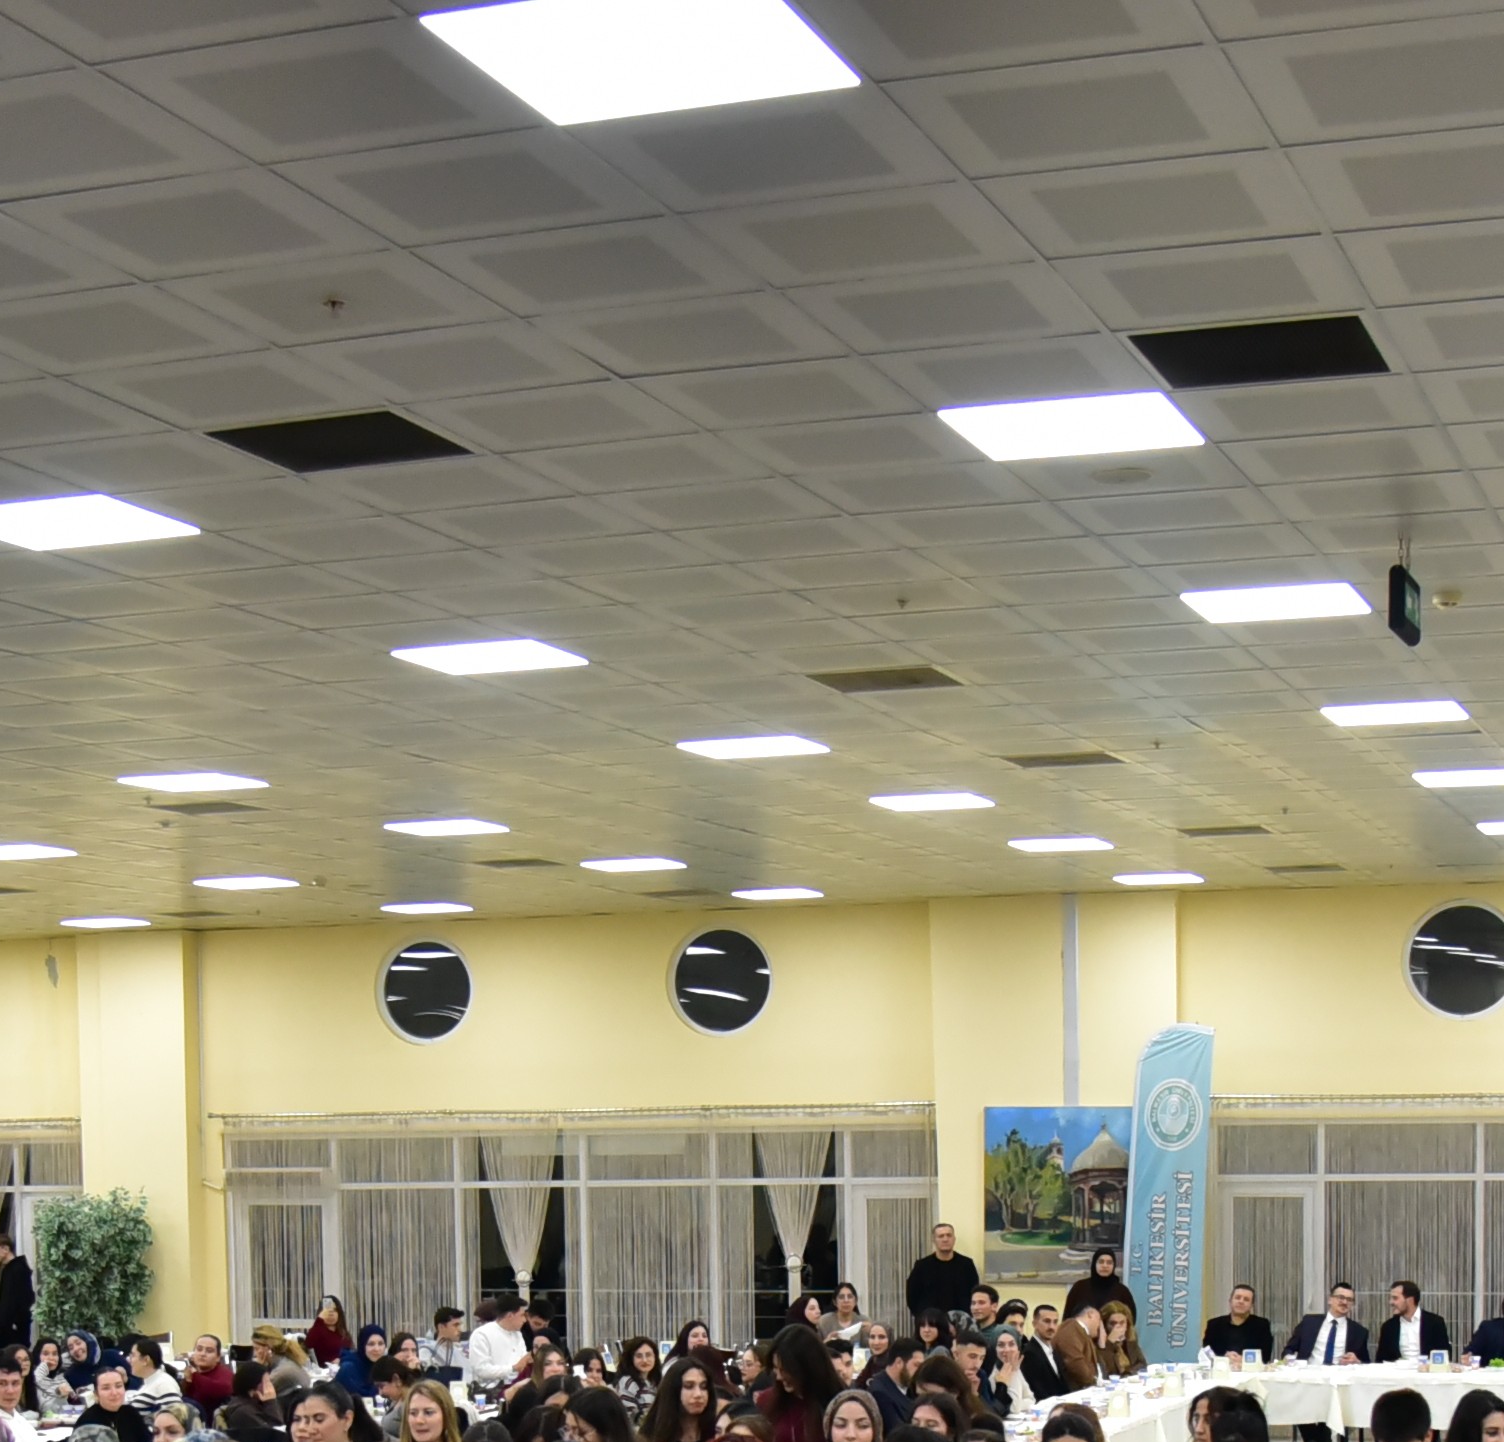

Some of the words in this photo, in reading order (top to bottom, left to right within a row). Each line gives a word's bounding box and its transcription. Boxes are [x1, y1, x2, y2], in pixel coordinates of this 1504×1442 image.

[1130, 1240, 1144, 1276] T.C.
[1147, 1191, 1166, 1327] BALIKESİR
[1168, 1171, 1193, 1348] ÜNİVERSİTESİ
